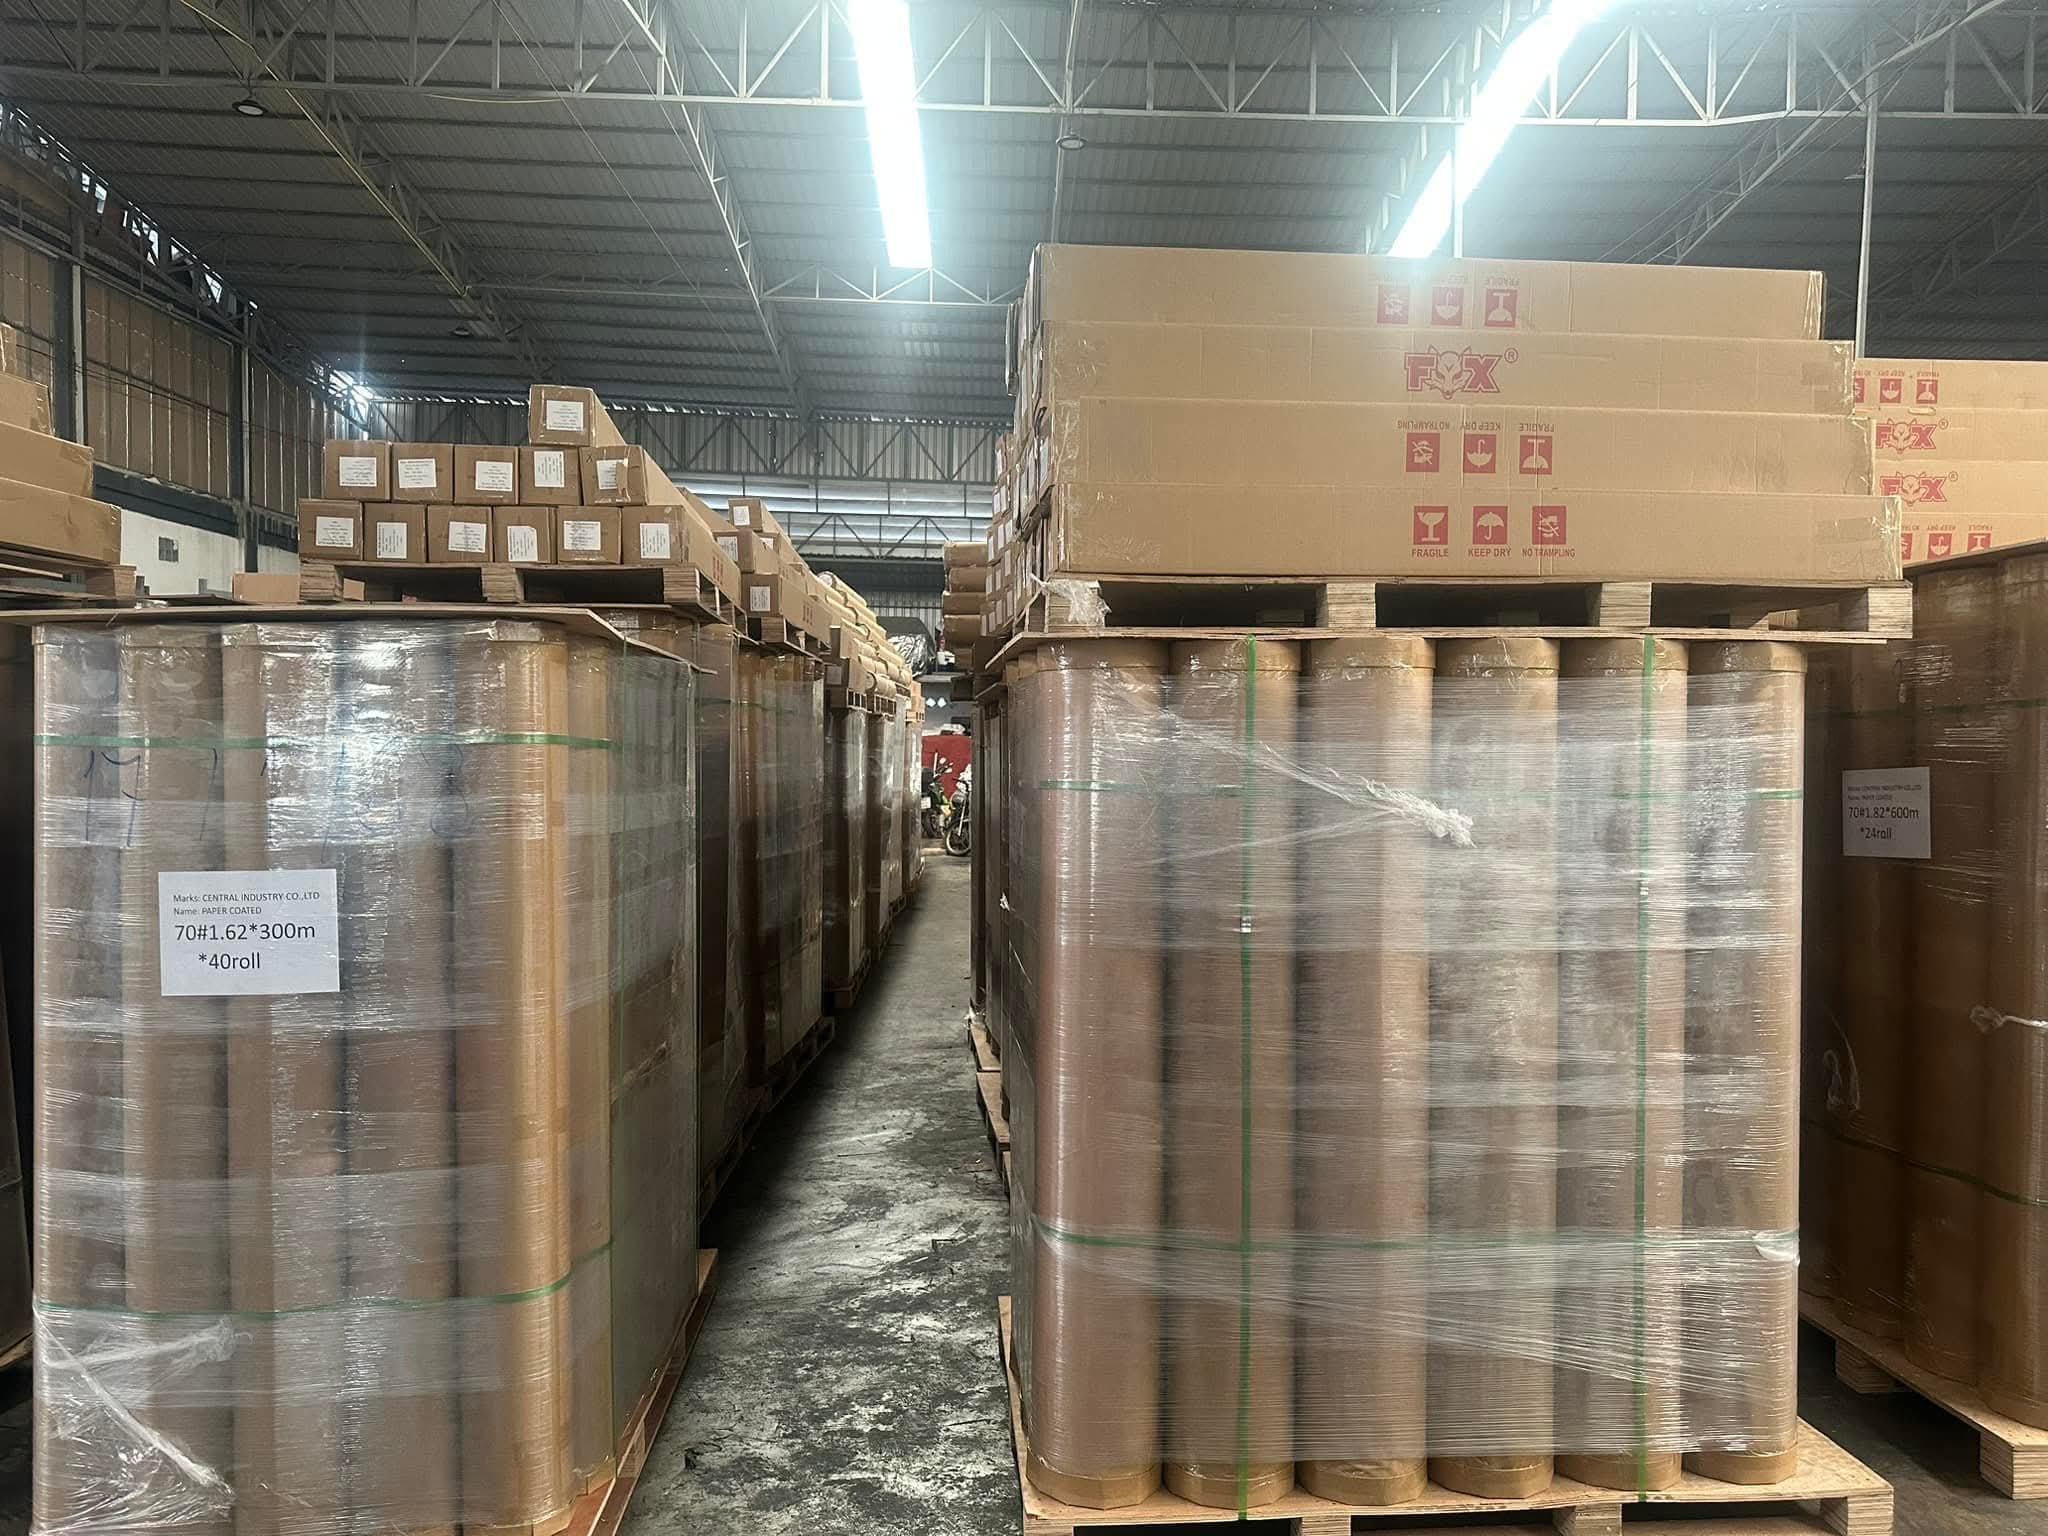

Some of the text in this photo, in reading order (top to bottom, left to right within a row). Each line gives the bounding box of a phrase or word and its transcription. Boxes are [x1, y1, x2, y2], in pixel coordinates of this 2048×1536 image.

[1398, 420, 1439, 430] TRAMPLING
[1460, 421, 1501, 431] KEEP DRY
[1519, 423, 1554, 432] FRAGILE
[1412, 548, 1449, 558] FRAGILE
[1468, 548, 1512, 557] KEEP DRY
[1522, 548, 1576, 558] NO TRAMPLING
[173, 894, 200, 903] Marks:
[202, 893, 238, 902] CENTRAL
[241, 892, 284, 902] INDUSTRY
[173, 906, 262, 915] Name: PAPER COATED
